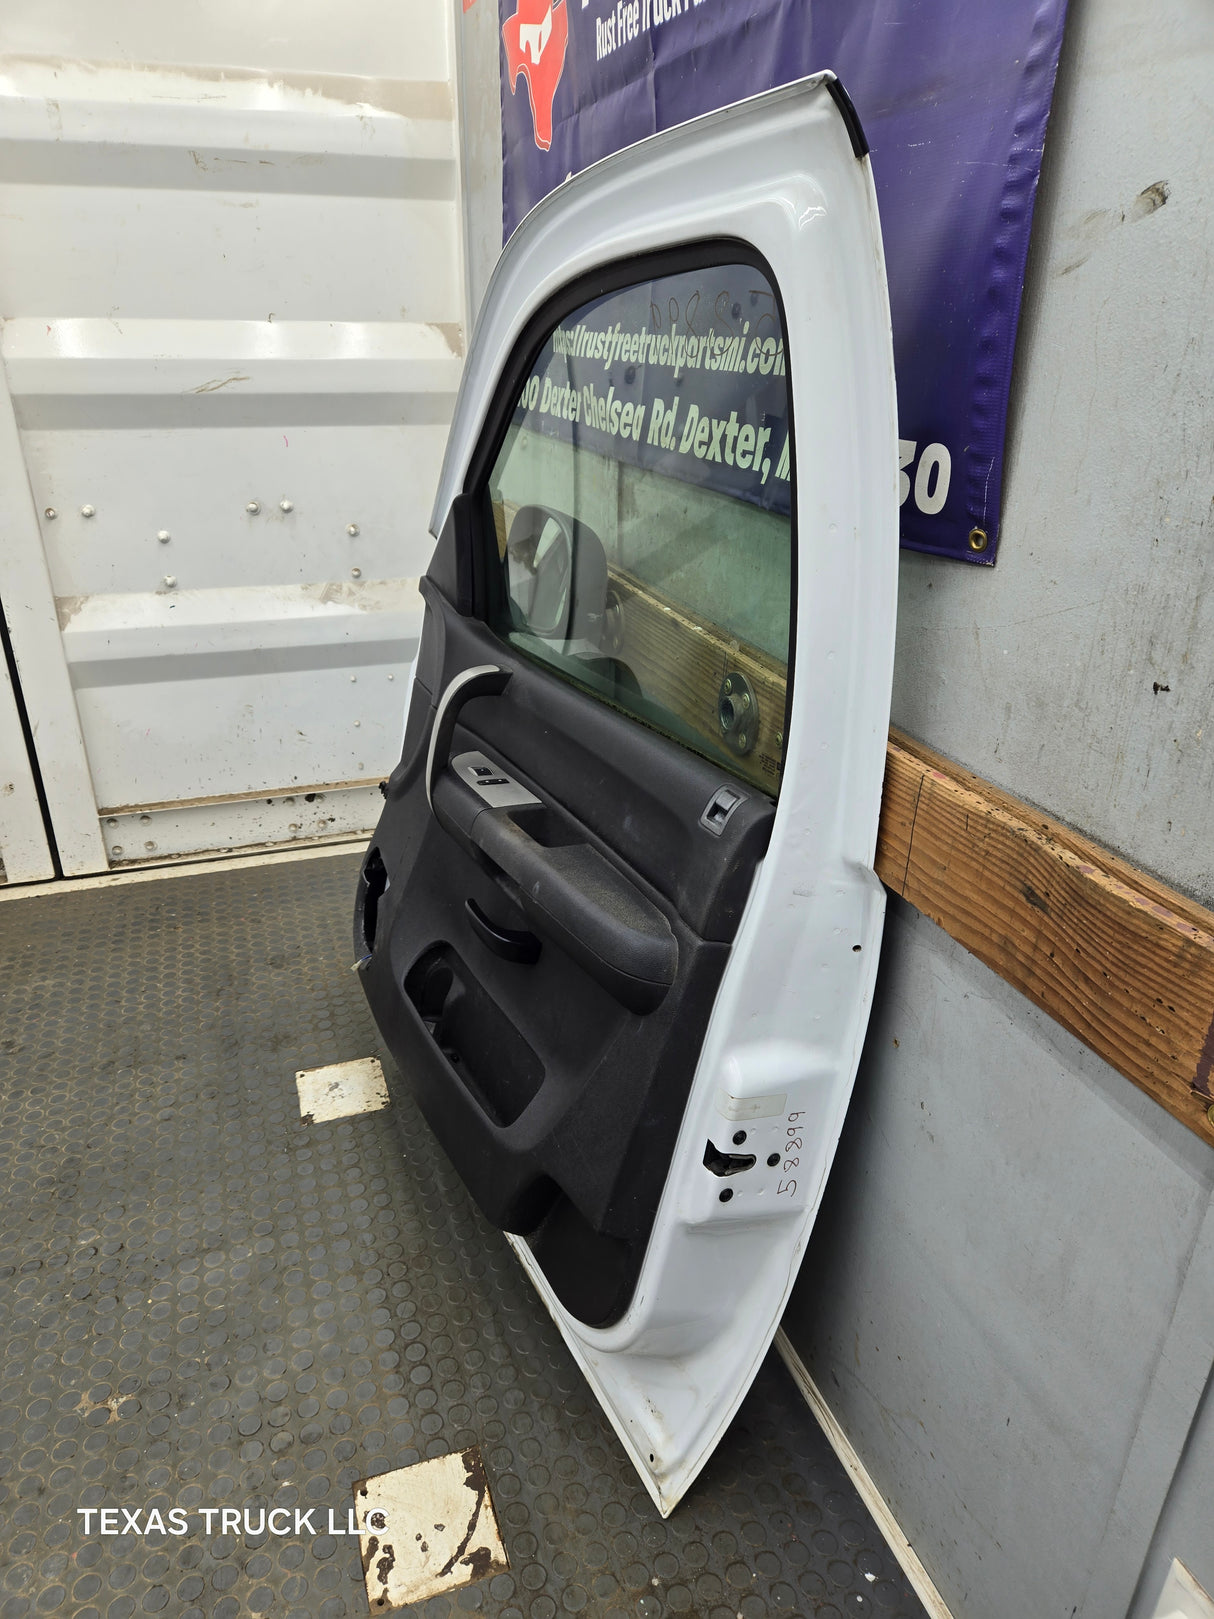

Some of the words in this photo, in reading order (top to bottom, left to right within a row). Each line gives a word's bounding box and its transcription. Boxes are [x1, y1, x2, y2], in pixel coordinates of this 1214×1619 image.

[595, 10, 617, 61] Rust
[617, 0, 640, 48] Free
[539, 377, 582, 423] Dexter
[582, 383, 646, 441] Chelsea
[646, 396, 680, 451] Rd.
[678, 404, 772, 485] Dexter,
[776, 1111, 806, 1198] 58899
